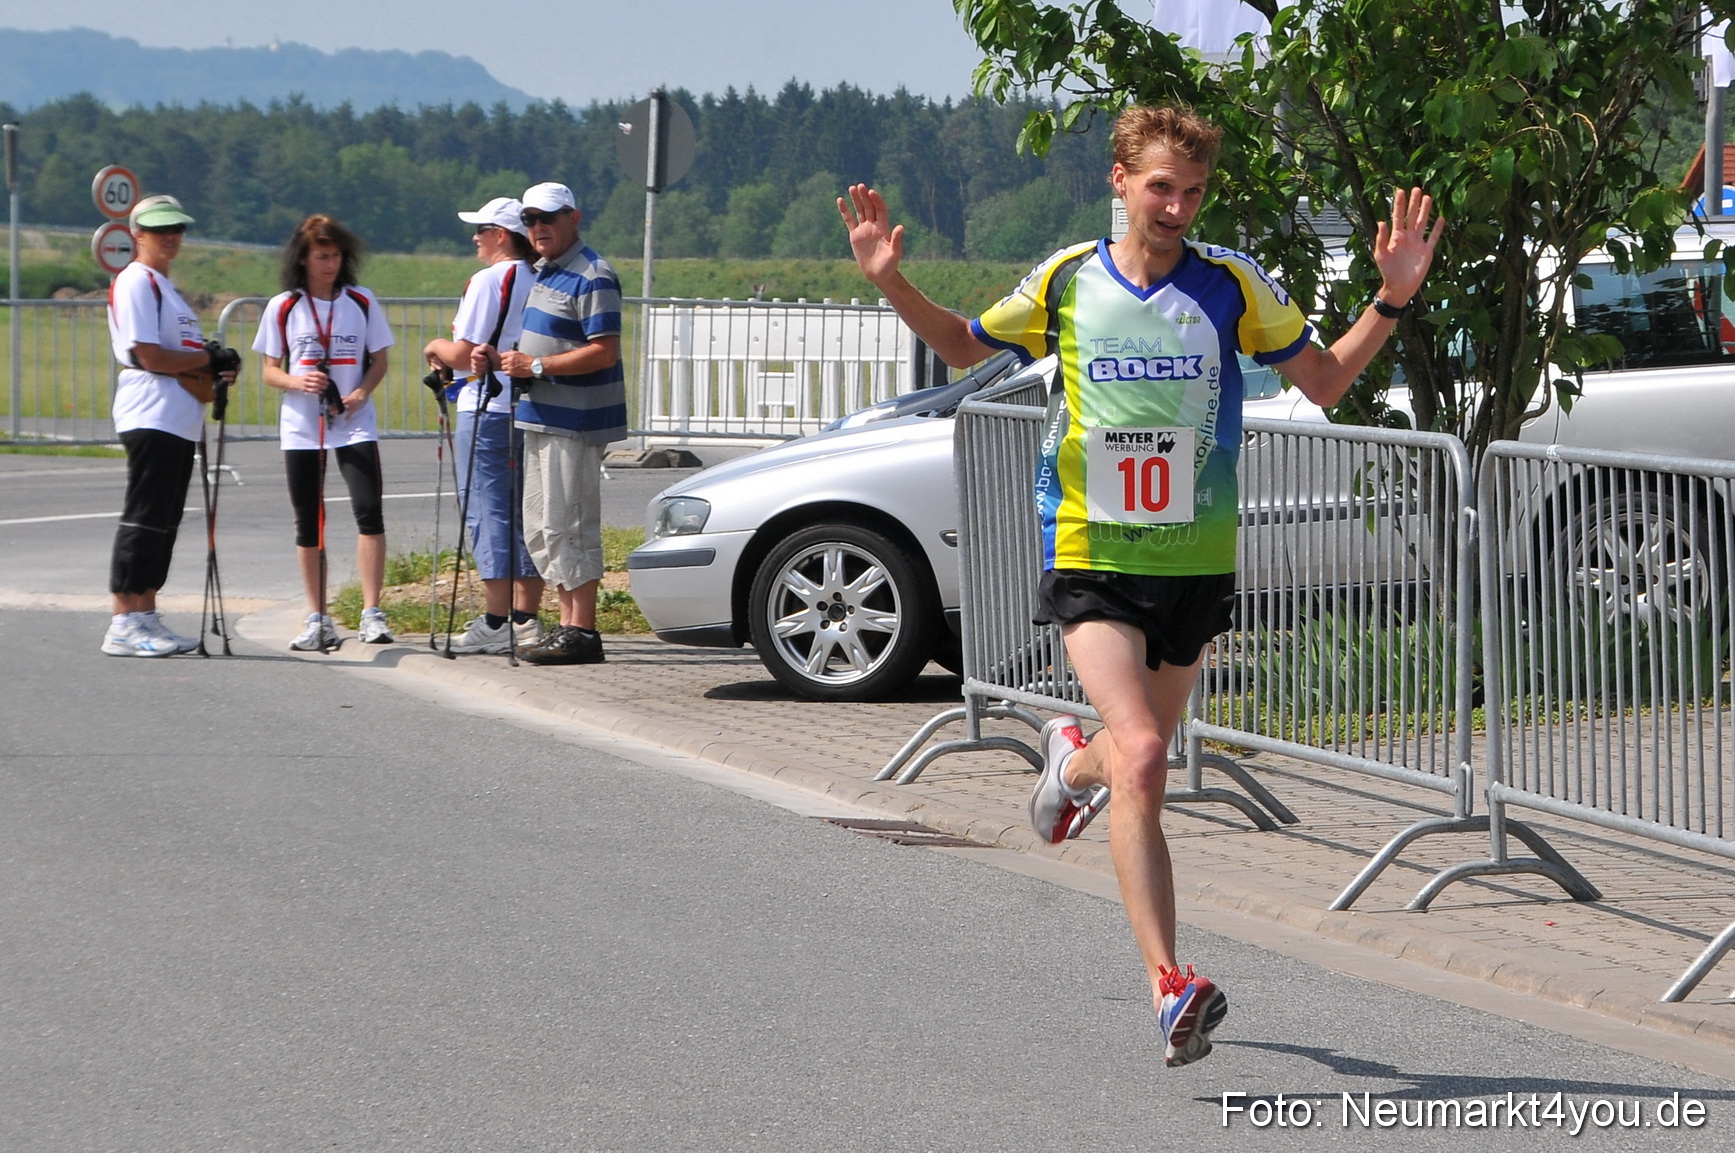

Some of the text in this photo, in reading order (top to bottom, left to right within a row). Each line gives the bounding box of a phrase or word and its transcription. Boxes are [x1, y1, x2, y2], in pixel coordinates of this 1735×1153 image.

[104, 180, 131, 205] 60
[1089, 336, 1162, 354] TEAM
[1088, 355, 1204, 382] BOCK
[1104, 431, 1155, 444] MEYER
[1104, 442, 1155, 453] WERBUNG
[1117, 456, 1170, 512] 10
